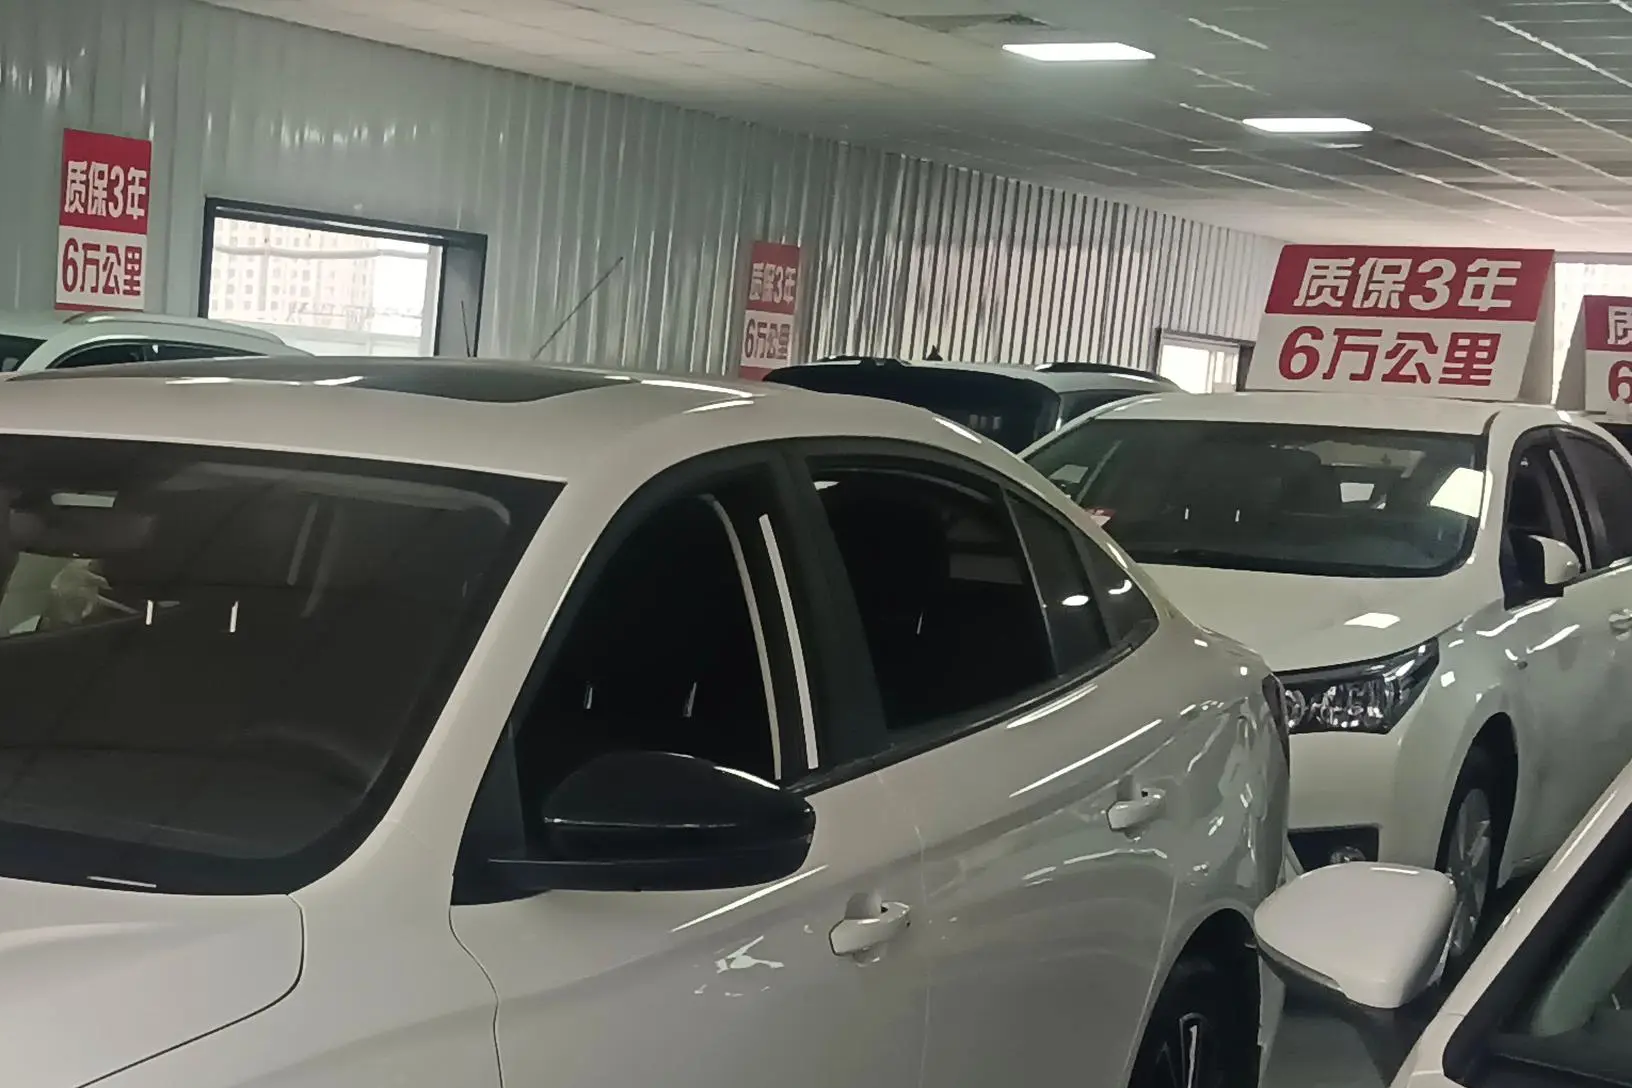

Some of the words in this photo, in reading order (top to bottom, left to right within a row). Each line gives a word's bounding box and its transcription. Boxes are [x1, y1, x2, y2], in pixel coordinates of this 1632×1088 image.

[64, 160, 148, 220] 质保3年
[62, 237, 143, 296] 6万公里
[1293, 256, 1523, 312] 质保3年
[1278, 325, 1502, 387] 6万公里
